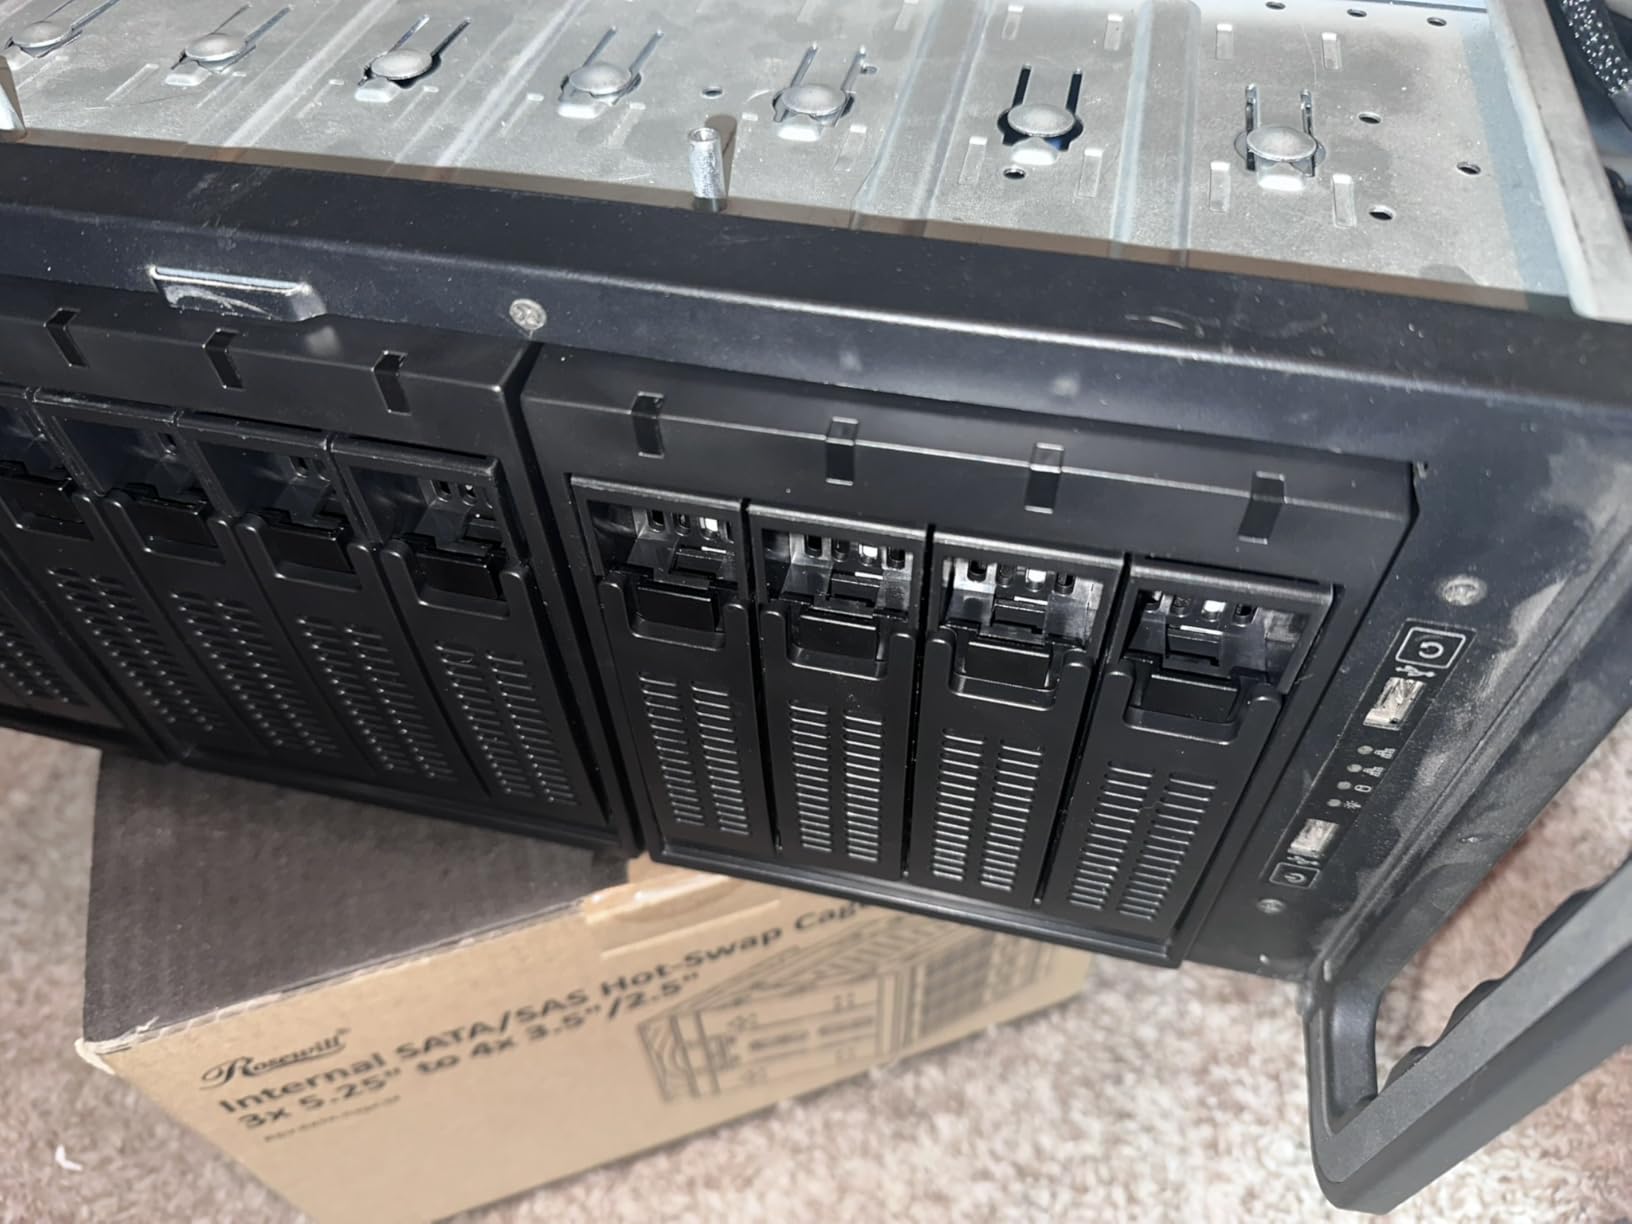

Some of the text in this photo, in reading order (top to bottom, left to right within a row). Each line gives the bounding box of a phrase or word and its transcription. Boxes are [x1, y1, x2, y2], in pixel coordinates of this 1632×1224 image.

[219, 900, 867, 1113] Internal SATA/SAS Hot-Swap Cag
[199, 1034, 346, 1090] Rosewill
[238, 1106, 291, 1130] 3x
[298, 1066, 402, 1110] 5.25"
[416, 1053, 461, 1074] to
[470, 1036, 516, 1058] 4x
